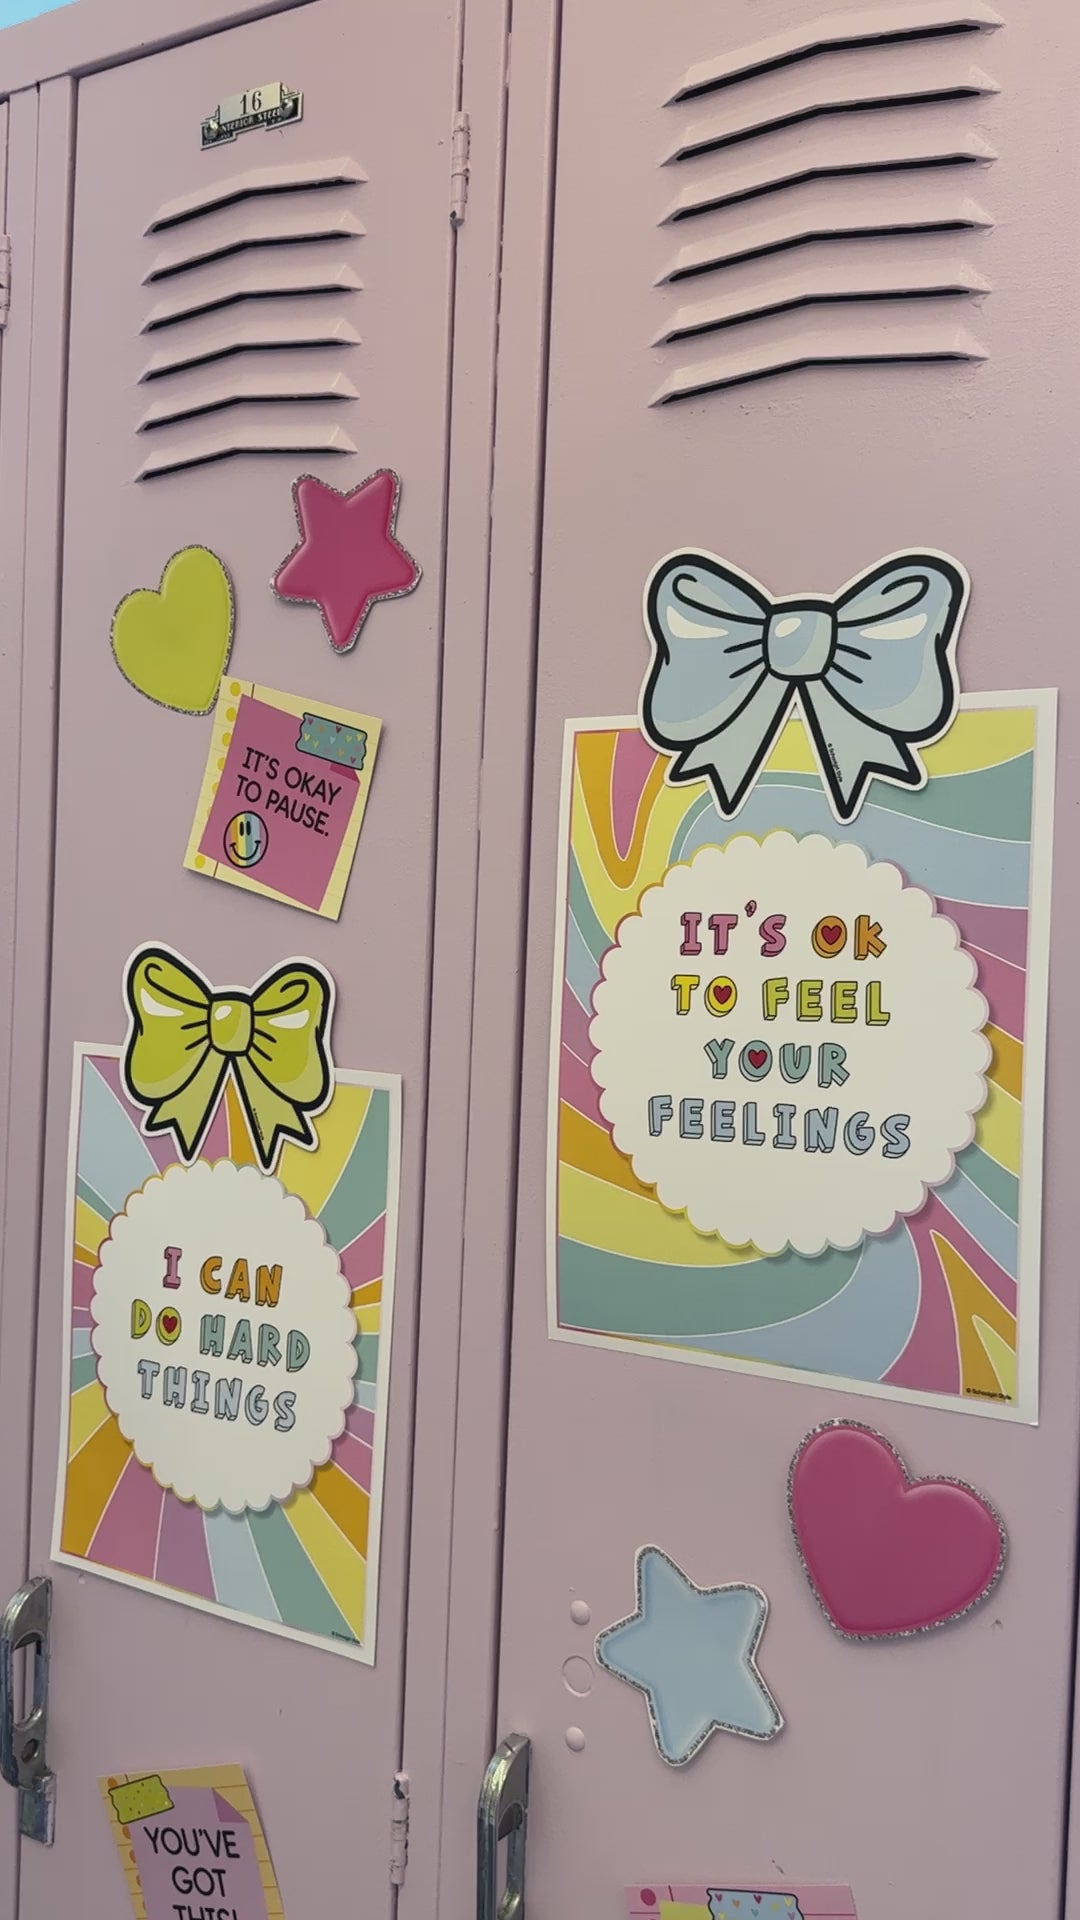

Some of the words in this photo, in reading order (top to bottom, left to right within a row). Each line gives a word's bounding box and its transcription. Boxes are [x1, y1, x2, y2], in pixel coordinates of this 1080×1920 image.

[240, 90, 262, 115] 16
[236, 774, 262, 803] TO
[265, 790, 330, 837] PAUSE.
[242, 747, 280, 780] IT'S
[284, 766, 342, 806] OKAY
[680, 900, 787, 958] IT'S
[811, 915, 887, 961] OK
[671, 974, 738, 1018] TO
[762, 977, 891, 1026] FEEL
[703, 1038, 850, 1088] YOUR
[648, 1095, 911, 1159] FEELINGS
[162, 1246, 182, 1290] I
[200, 1256, 283, 1308] CAN
[131, 1299, 182, 1346] DO
[200, 1314, 311, 1373] HARD
[137, 1359, 297, 1432] THINGS
[143, 1826, 241, 1859] YOU'VE
[171, 1866, 227, 1897] GOT
